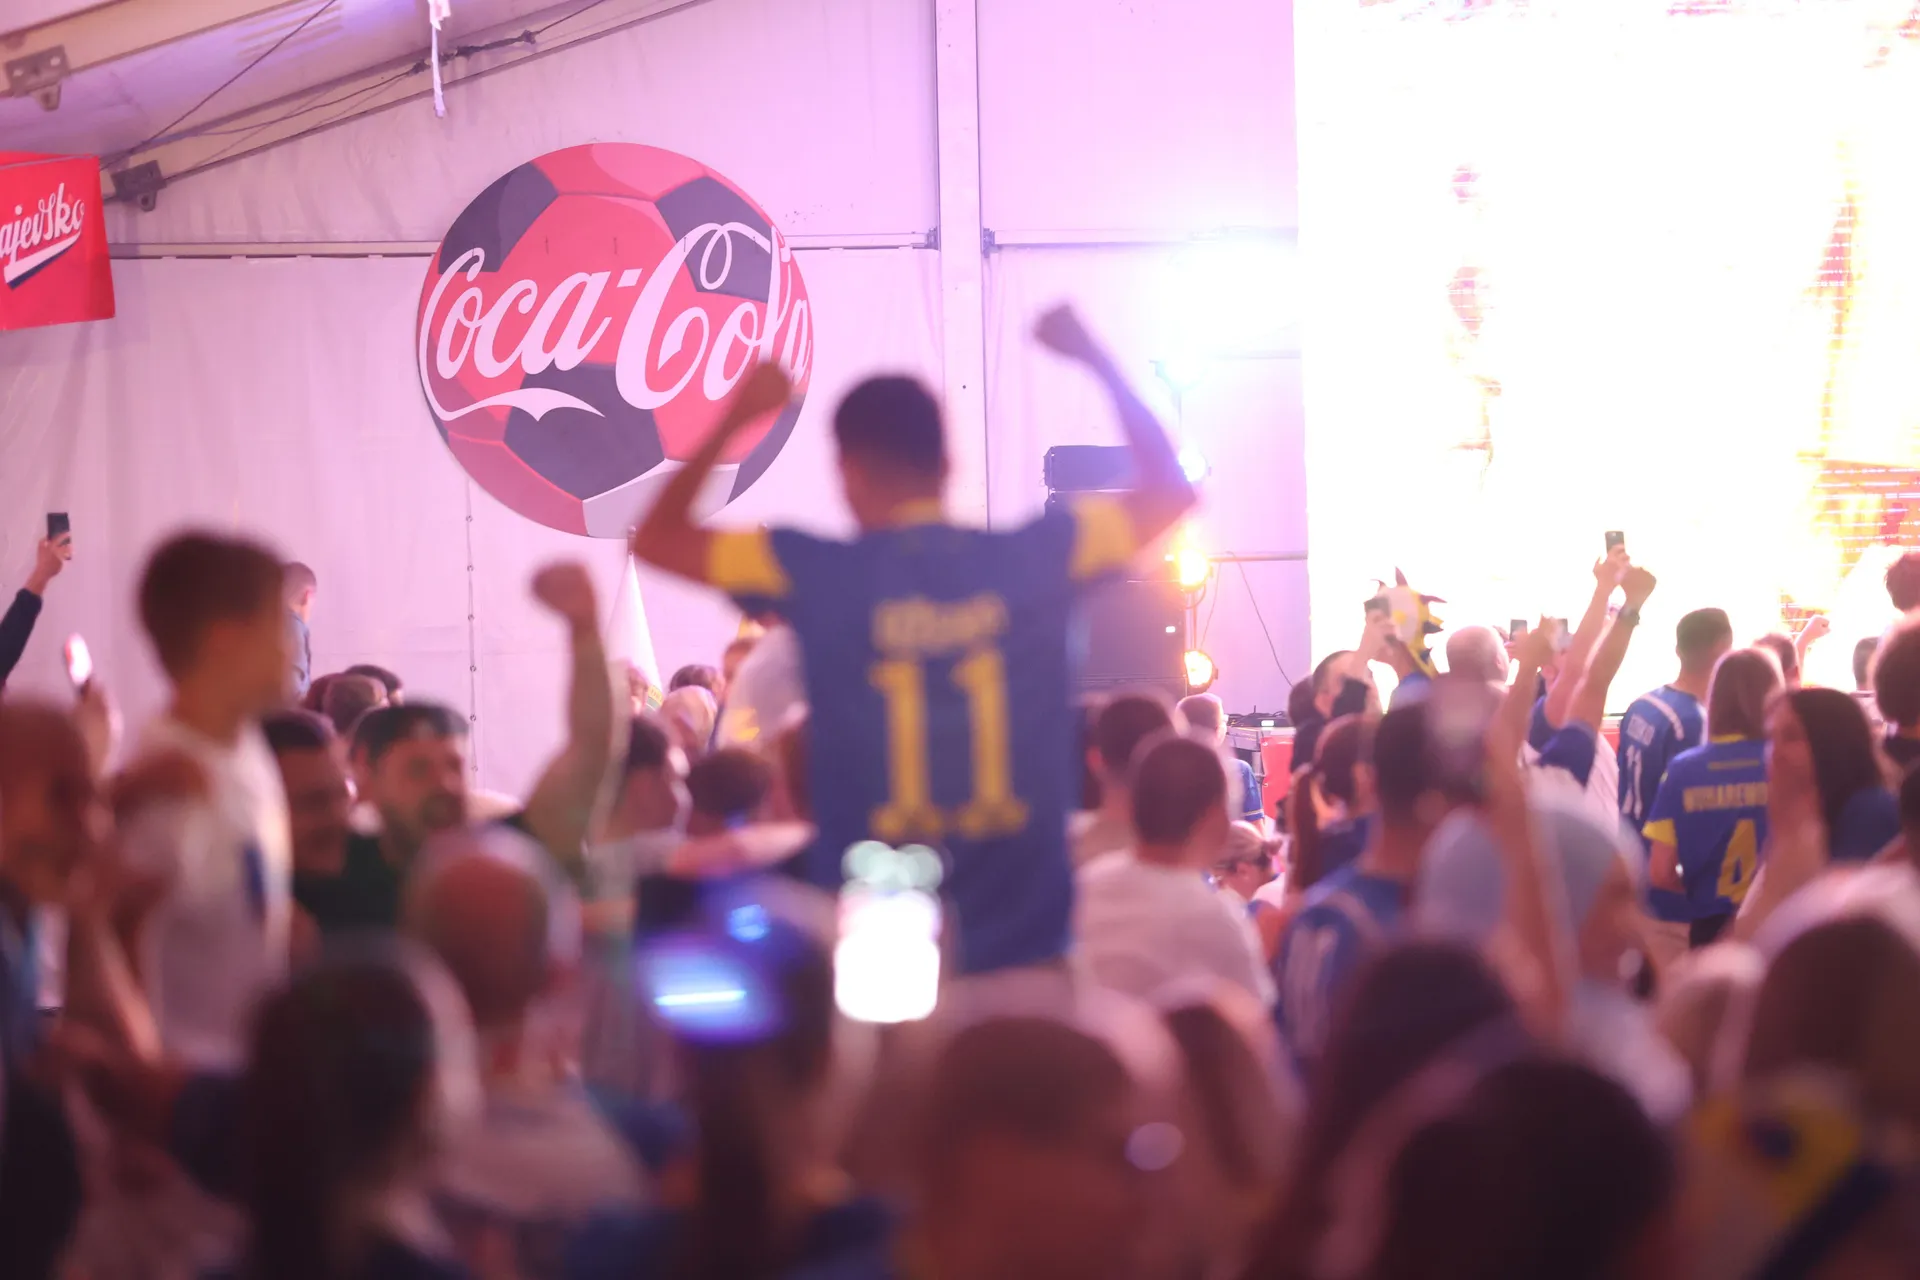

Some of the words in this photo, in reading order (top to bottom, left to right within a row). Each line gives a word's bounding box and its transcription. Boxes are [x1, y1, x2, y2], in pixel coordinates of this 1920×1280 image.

[0, 182, 85, 270] ajevsko
[419, 222, 812, 422] Coca-Cola
[867, 652, 1030, 843] 11
[1717, 818, 1757, 904] 4
